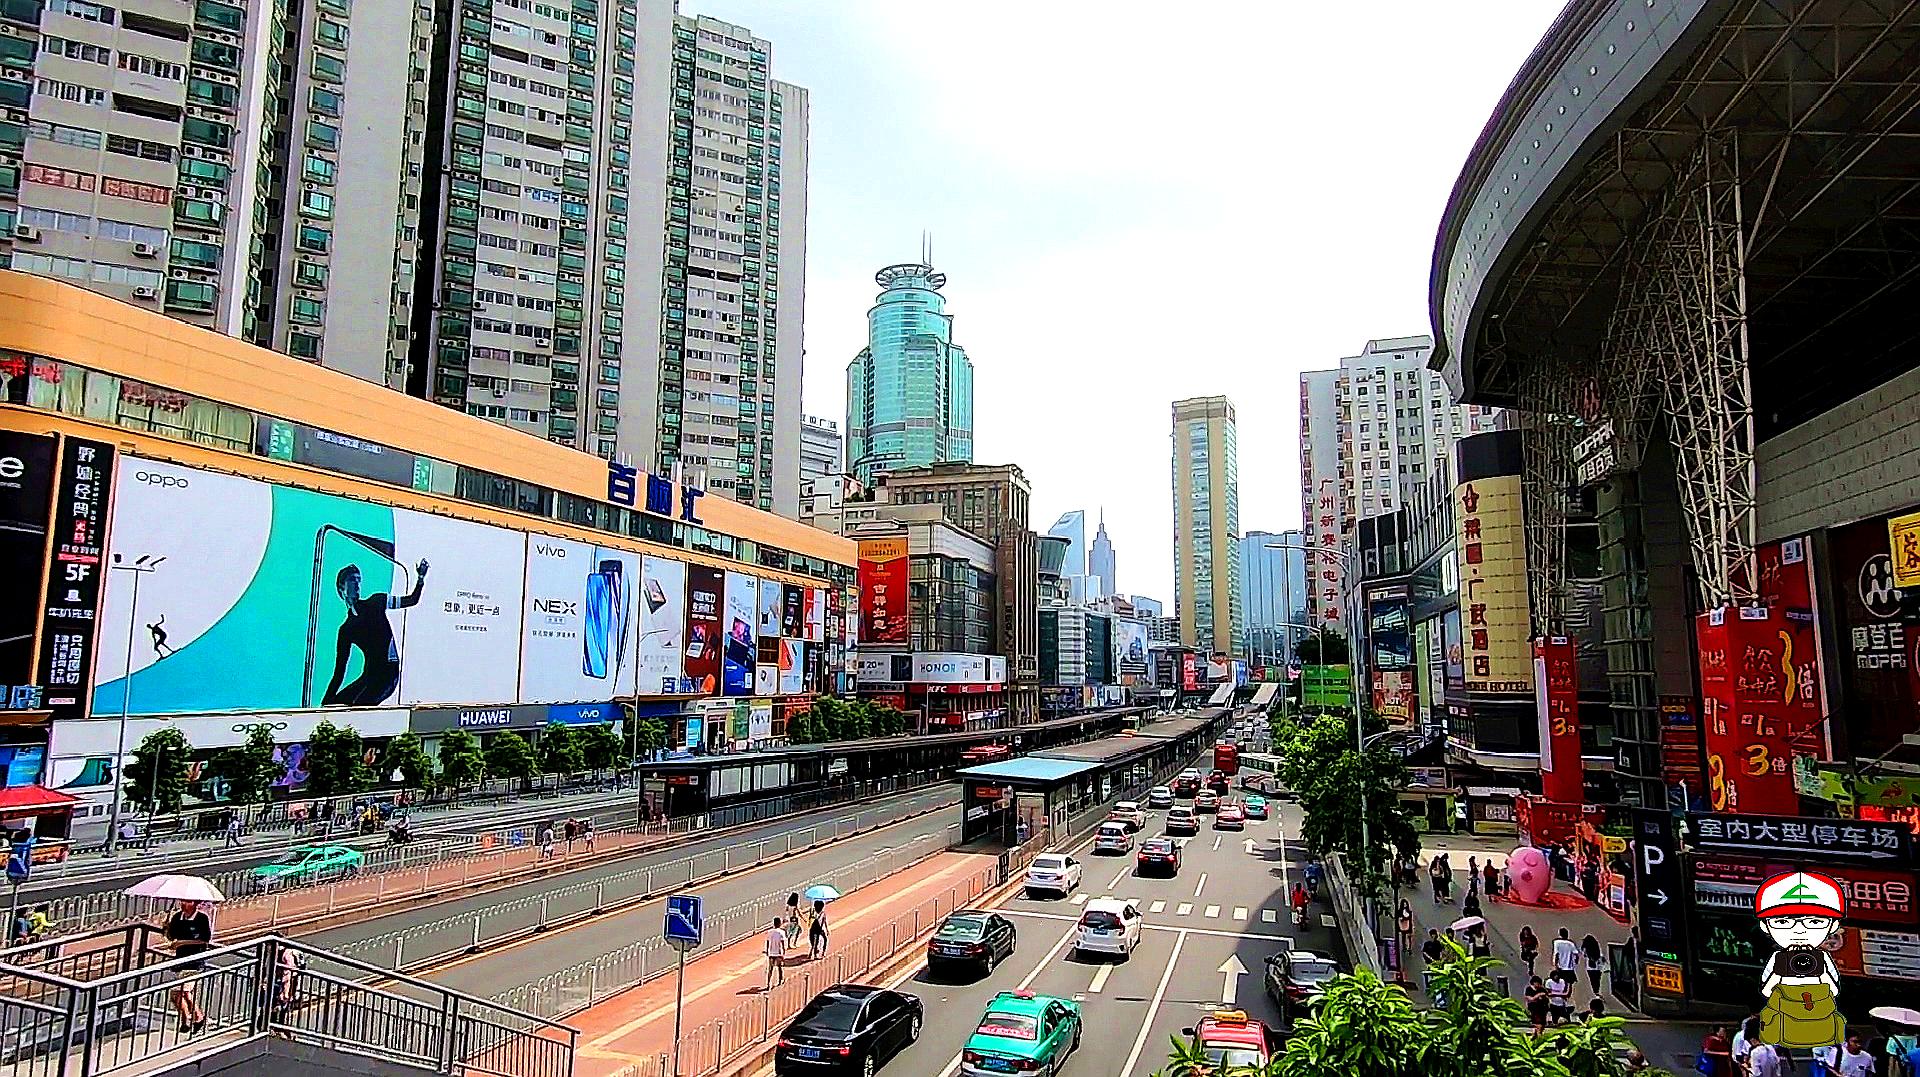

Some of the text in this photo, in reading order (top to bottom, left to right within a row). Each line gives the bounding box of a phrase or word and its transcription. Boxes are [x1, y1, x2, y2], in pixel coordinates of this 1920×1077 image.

[536, 543, 566, 558] vivo
[65, 564, 91, 581] 5F
[533, 598, 577, 616] NEX
[920, 663, 956, 673] HONOR
[928, 685, 947, 693] KFC
[459, 709, 511, 726] HUAWEI
[1698, 818, 1898, 849] 室内大型停车场
[1644, 845, 1664, 874] P
